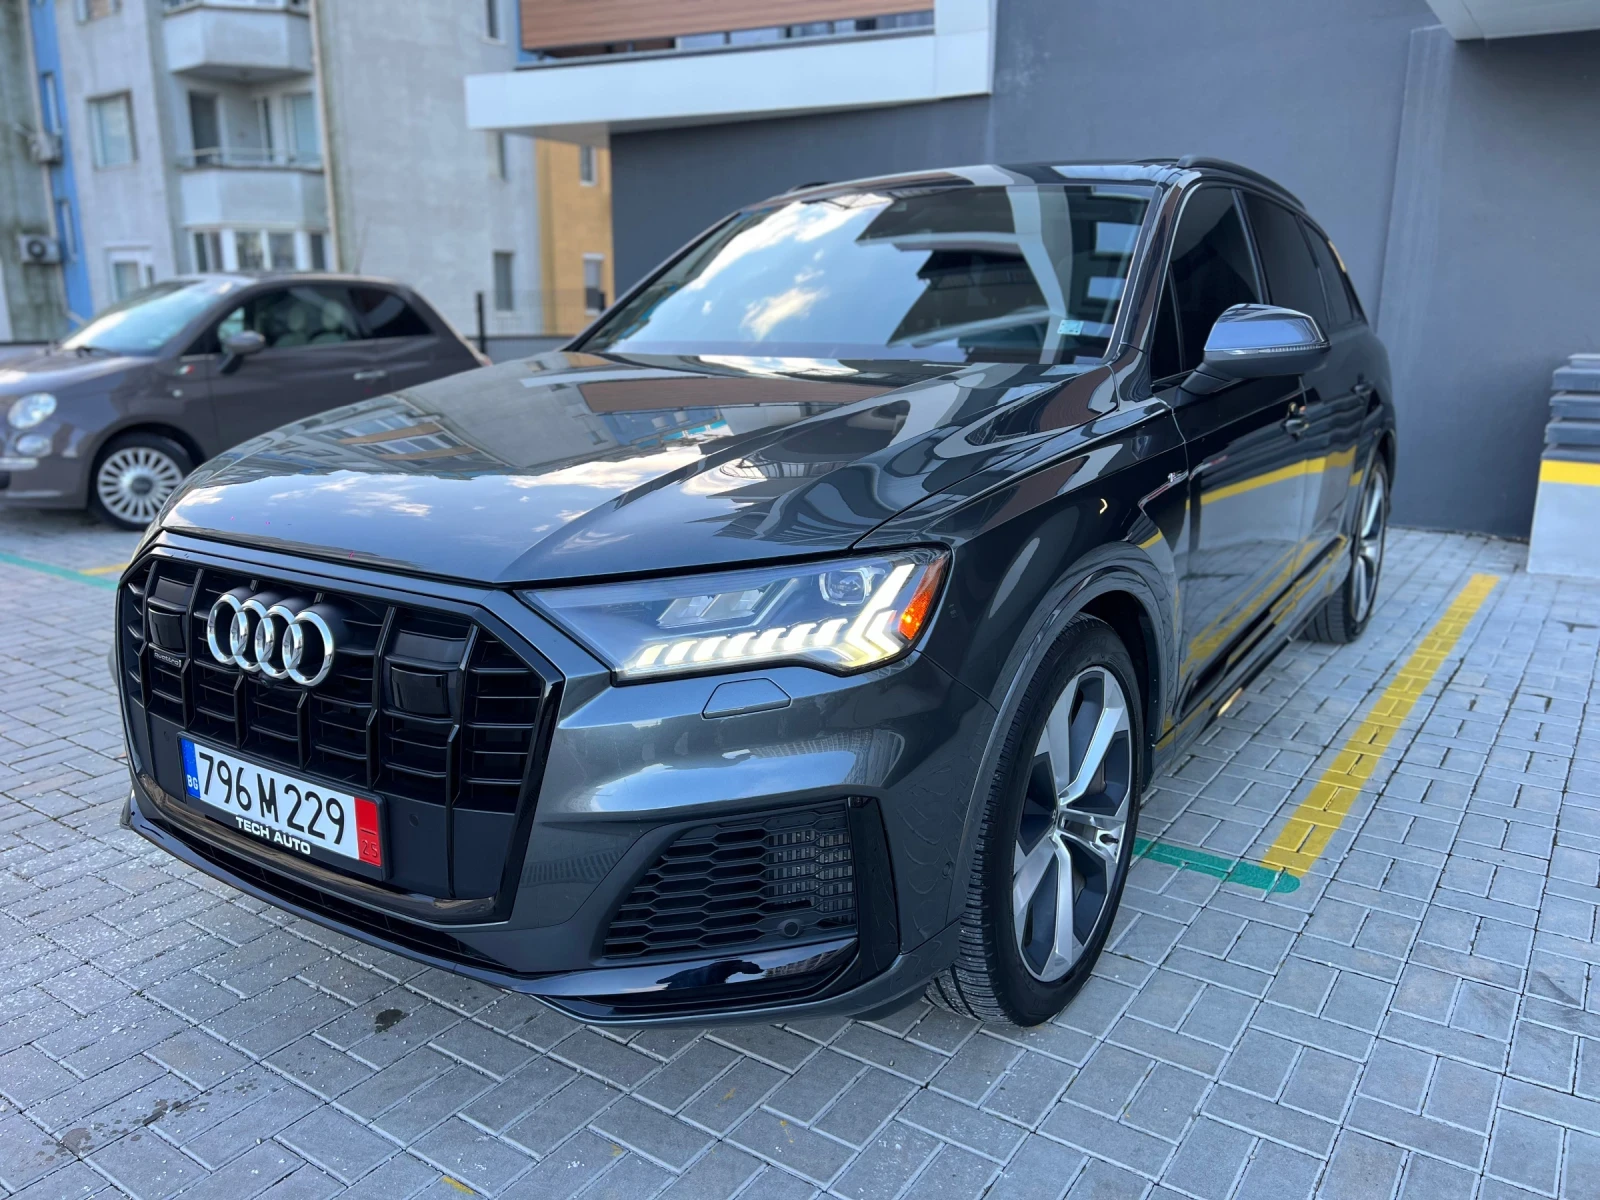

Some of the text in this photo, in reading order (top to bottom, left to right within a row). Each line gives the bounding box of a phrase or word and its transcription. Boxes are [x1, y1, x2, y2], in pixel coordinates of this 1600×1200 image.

[187, 774, 199, 790] BG
[199, 751, 345, 845] 796 M 229
[236, 816, 311, 855] TECH AUTO
[362, 840, 378, 858] 25
